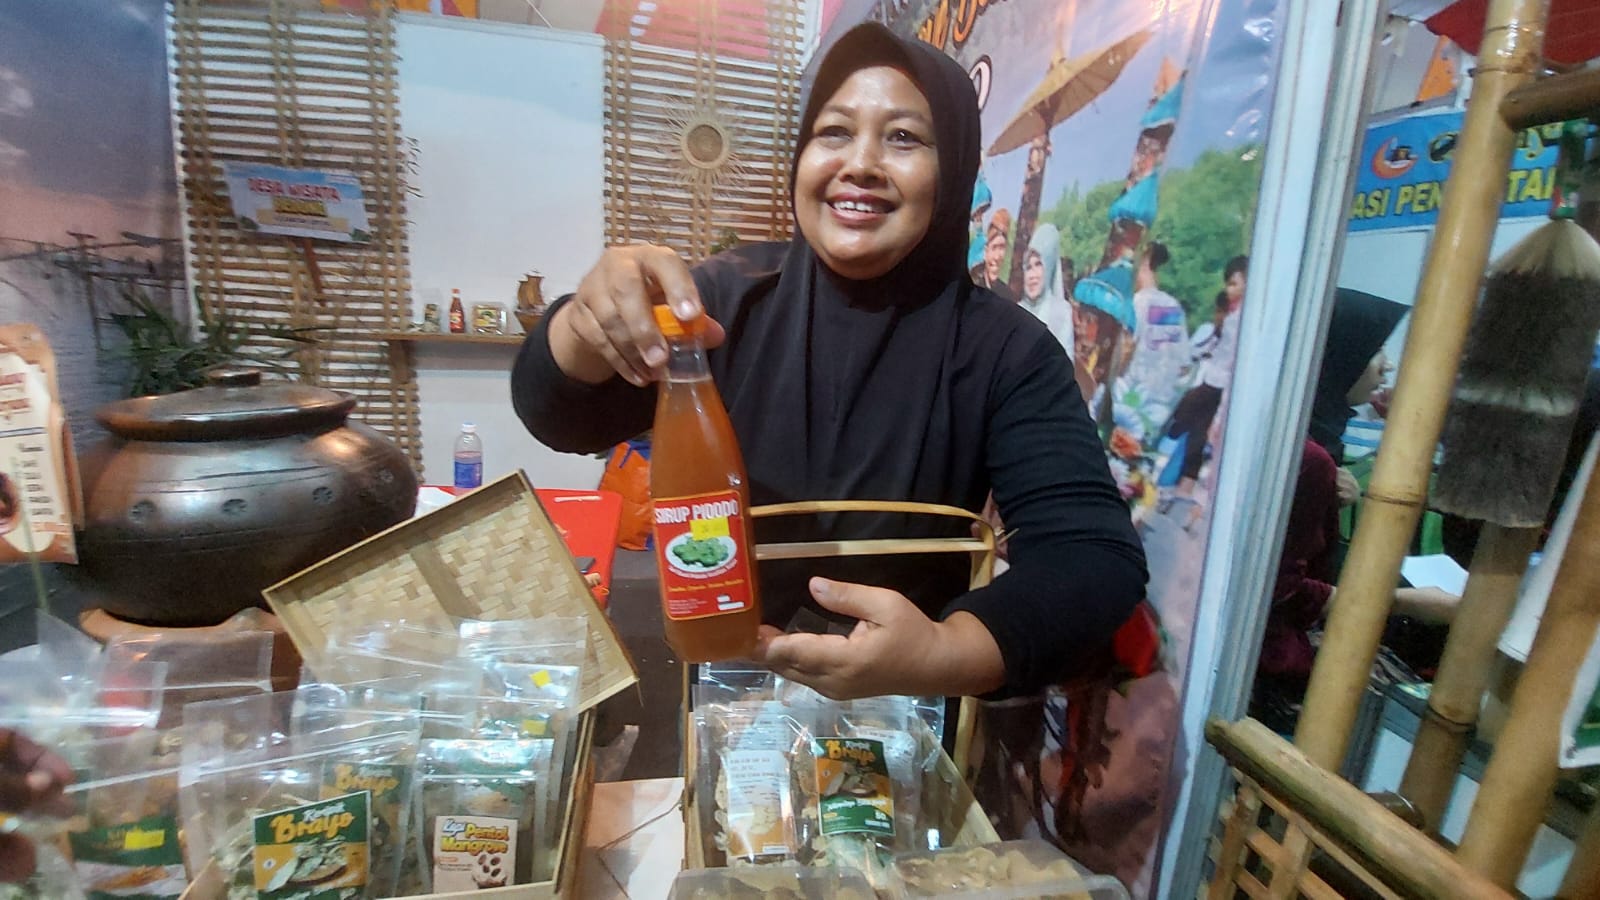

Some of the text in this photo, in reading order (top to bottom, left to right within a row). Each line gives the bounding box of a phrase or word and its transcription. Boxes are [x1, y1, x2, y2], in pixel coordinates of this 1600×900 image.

[654, 506, 690, 524] SIRUP
[269, 812, 356, 844] Brayo
[440, 835, 509, 856] Mangrove
